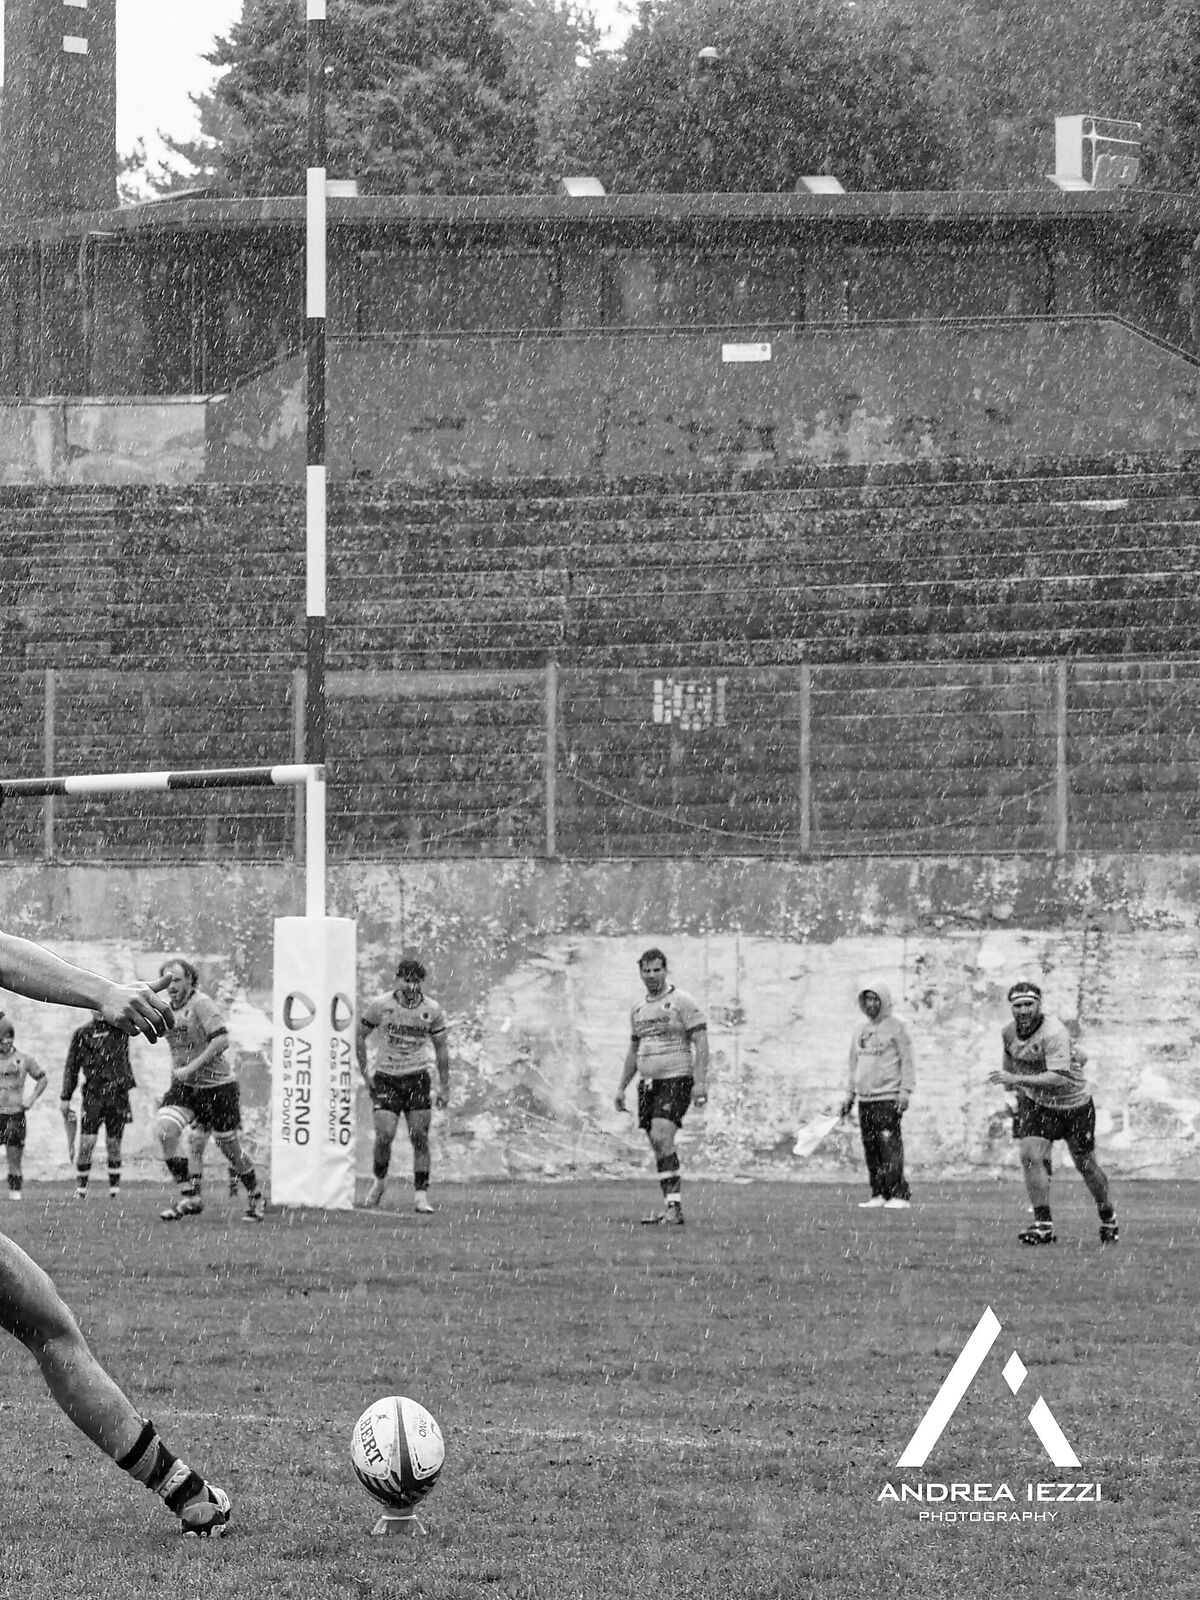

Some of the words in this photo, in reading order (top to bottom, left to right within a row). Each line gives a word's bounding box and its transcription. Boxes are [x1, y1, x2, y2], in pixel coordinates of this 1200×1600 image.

[283, 1036, 294, 1069] Gas
[282, 1087, 294, 1144] Power
[295, 1037, 312, 1146] ATERNO
[328, 1087, 338, 1144] Power
[339, 1038, 352, 1147] ATERNO
